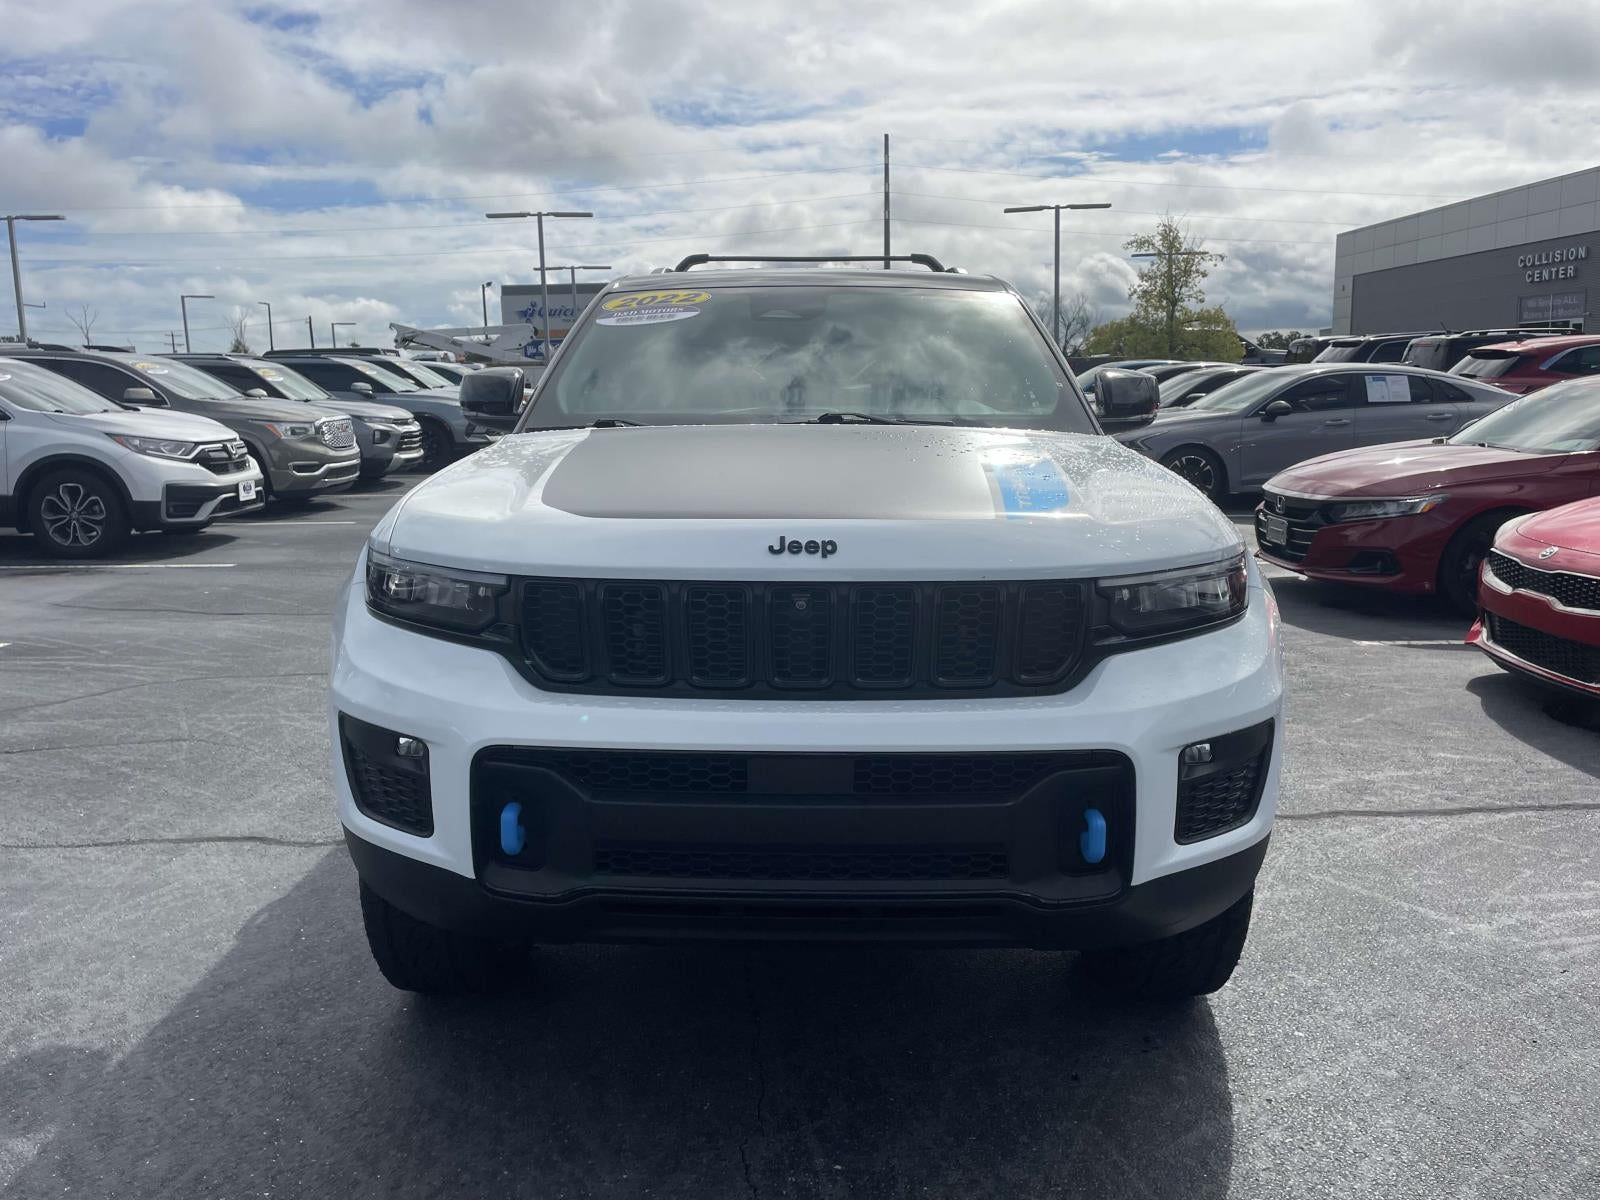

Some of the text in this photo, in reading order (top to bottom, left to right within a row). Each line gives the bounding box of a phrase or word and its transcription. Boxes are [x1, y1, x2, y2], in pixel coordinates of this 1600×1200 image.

[1518, 246, 1586, 268] COLLISION
[1525, 265, 1574, 283] CENTER
[611, 292, 704, 309] 2022
[768, 535, 838, 559] Jeep
